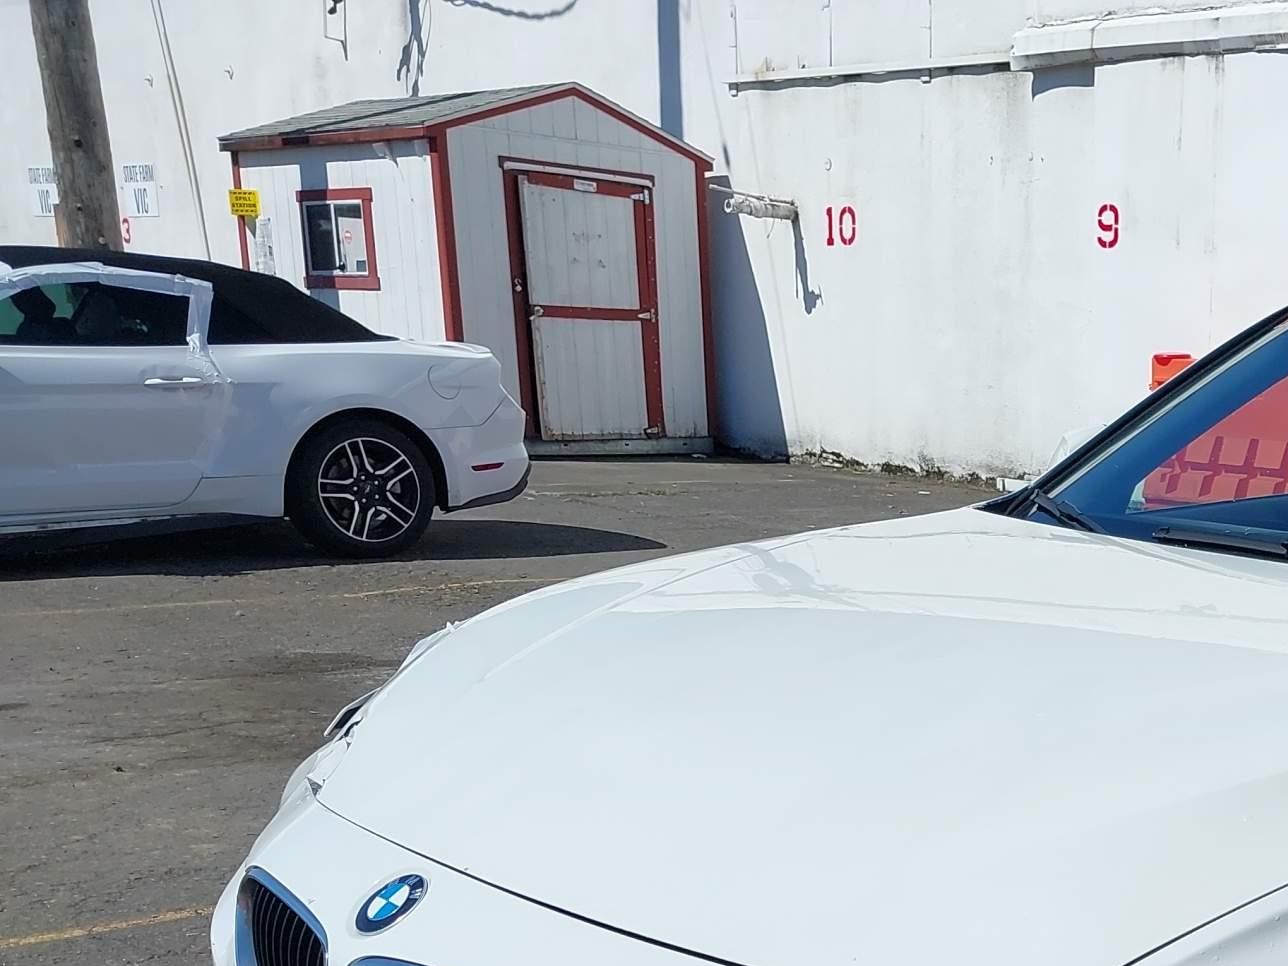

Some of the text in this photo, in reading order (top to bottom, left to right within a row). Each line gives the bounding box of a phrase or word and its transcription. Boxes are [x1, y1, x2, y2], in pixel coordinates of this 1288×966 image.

[123, 164, 155, 183] STATE FARM
[38, 189, 52, 214] VIC
[133, 187, 149, 214] VIC
[826, 206, 857, 246] 10
[1097, 204, 1119, 249] 9
